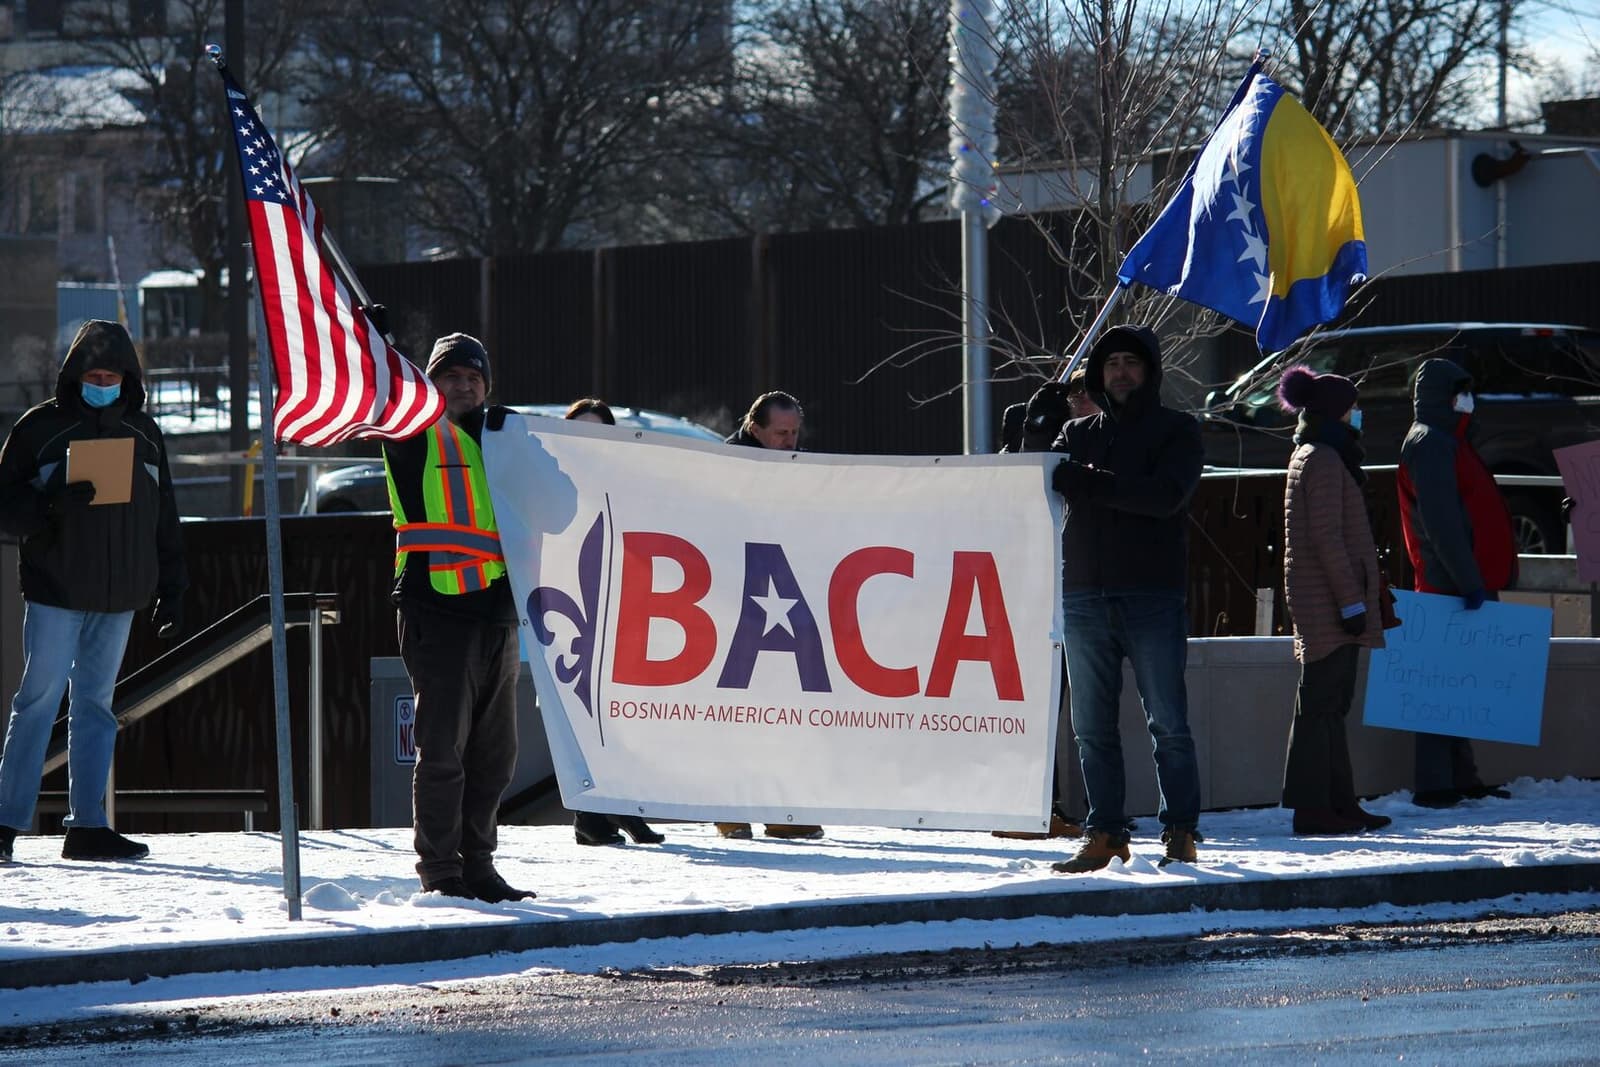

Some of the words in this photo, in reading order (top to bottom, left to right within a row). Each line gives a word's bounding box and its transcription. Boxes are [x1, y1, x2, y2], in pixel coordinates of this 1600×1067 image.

[611, 531, 1025, 702] BACA
[1443, 609, 1533, 649] Further
[1384, 649, 1478, 689] Partition
[1494, 671, 1520, 697] of
[609, 700, 802, 726] BOSNIAN-AMERICAN
[808, 708, 915, 731] COMMUNITY
[919, 713, 1026, 735] ASSOCIATION
[1400, 692, 1497, 728] Bosnia
